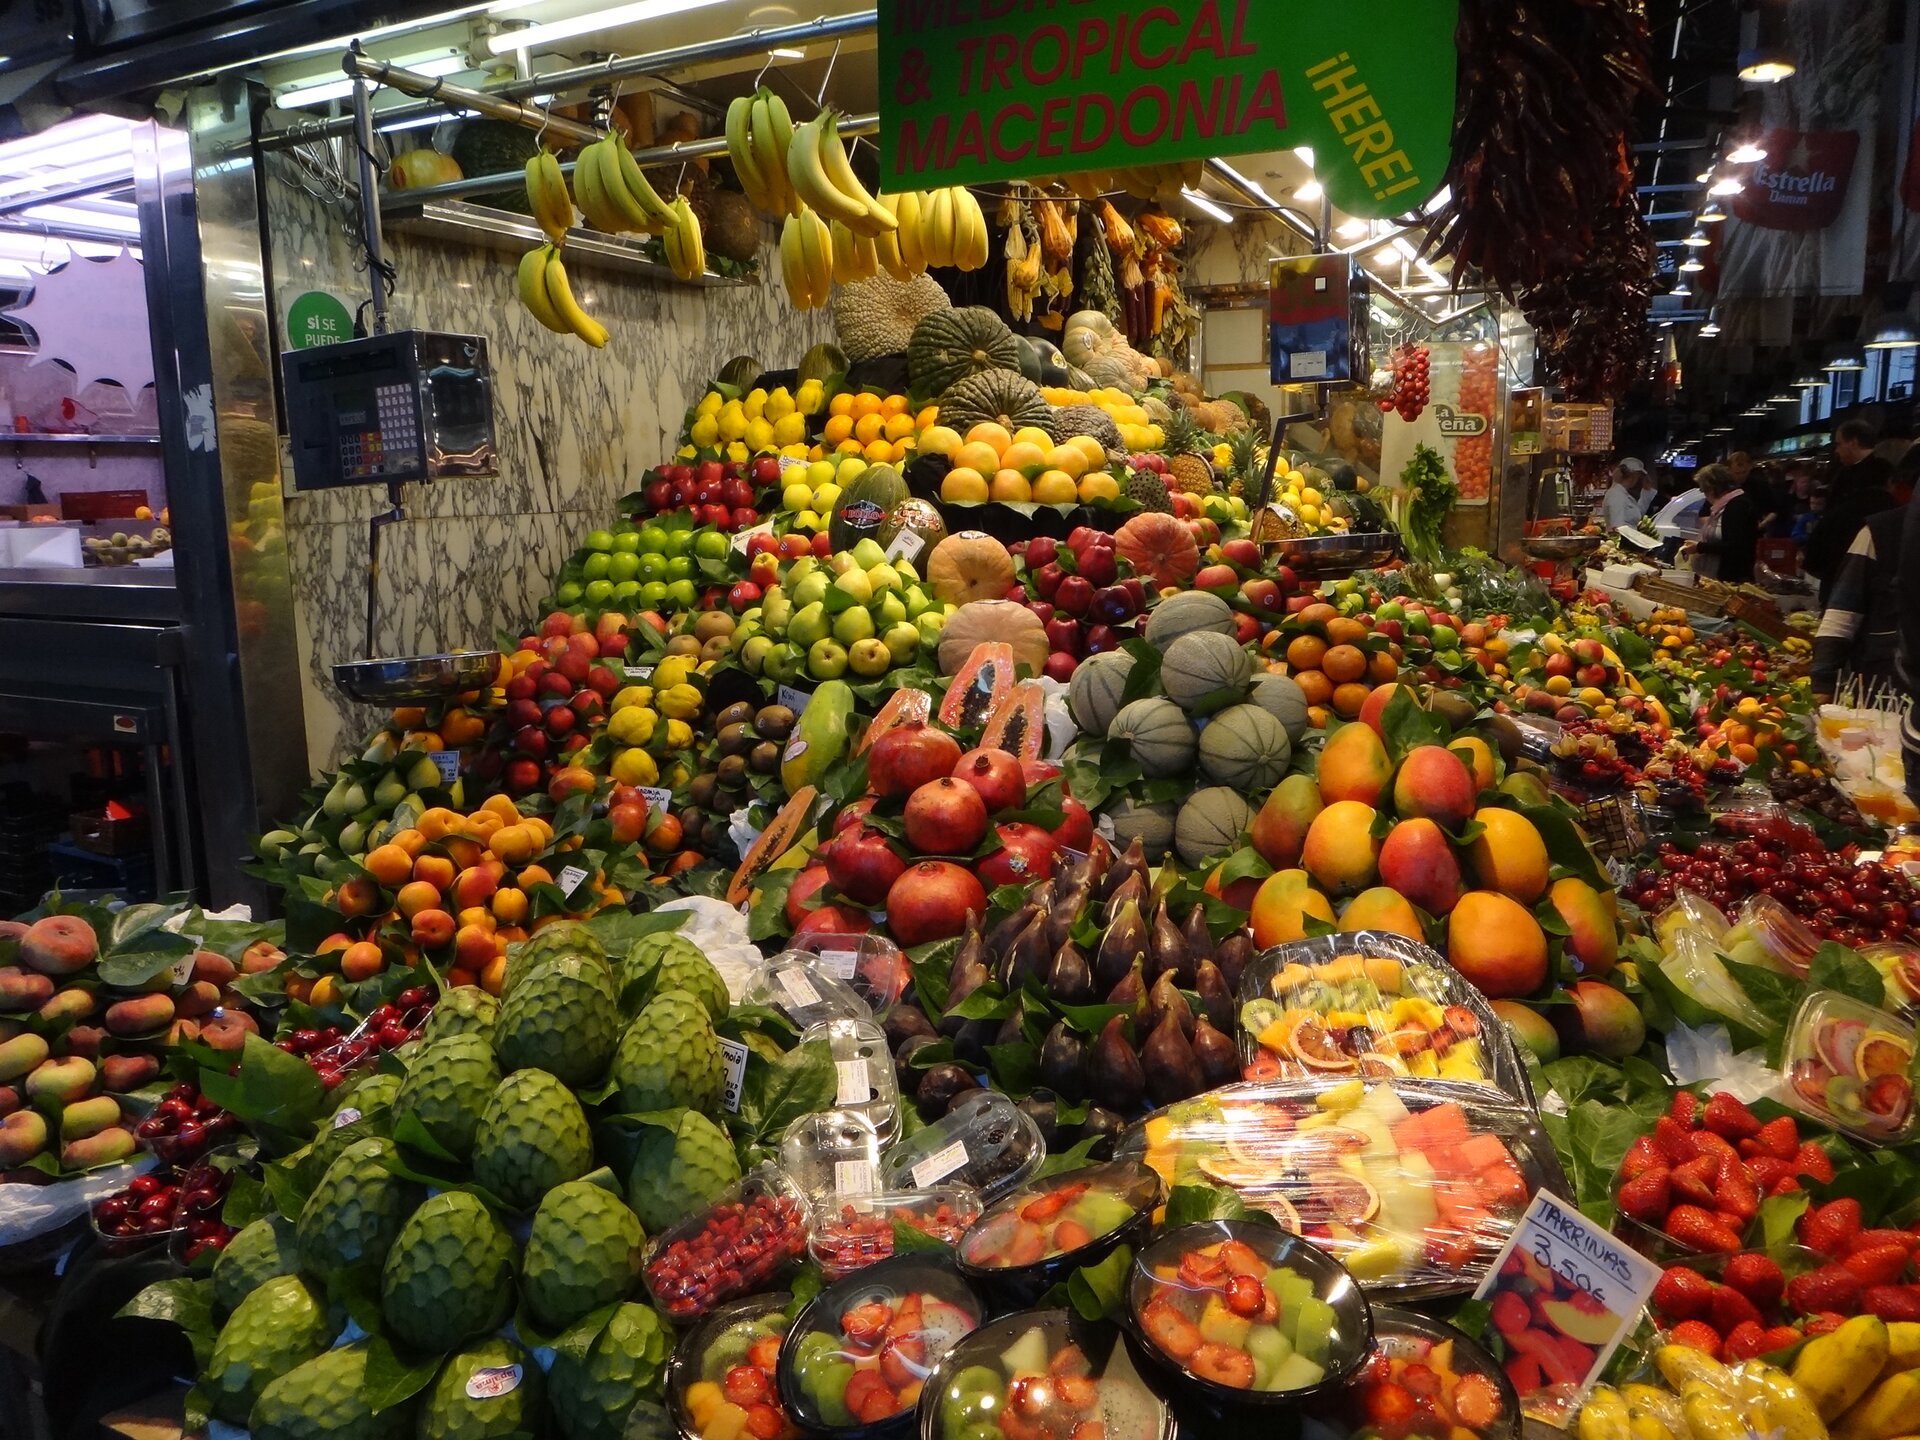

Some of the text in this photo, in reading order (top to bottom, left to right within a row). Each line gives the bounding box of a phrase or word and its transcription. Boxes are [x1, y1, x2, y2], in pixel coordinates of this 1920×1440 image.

[897, 47, 934, 105] &
[957, 0, 1260, 98] TROPICAL
[893, 69, 1288, 176] MACEDONIA
[1305, 51, 1421, 201] ¡HERE!
[1753, 162, 1836, 193] Estrella
[1769, 189, 1808, 205] Damm
[322, 318, 337, 331] SE
[1438, 417, 1477, 431] eña
[1536, 1200, 1632, 1281] TARRINAS
